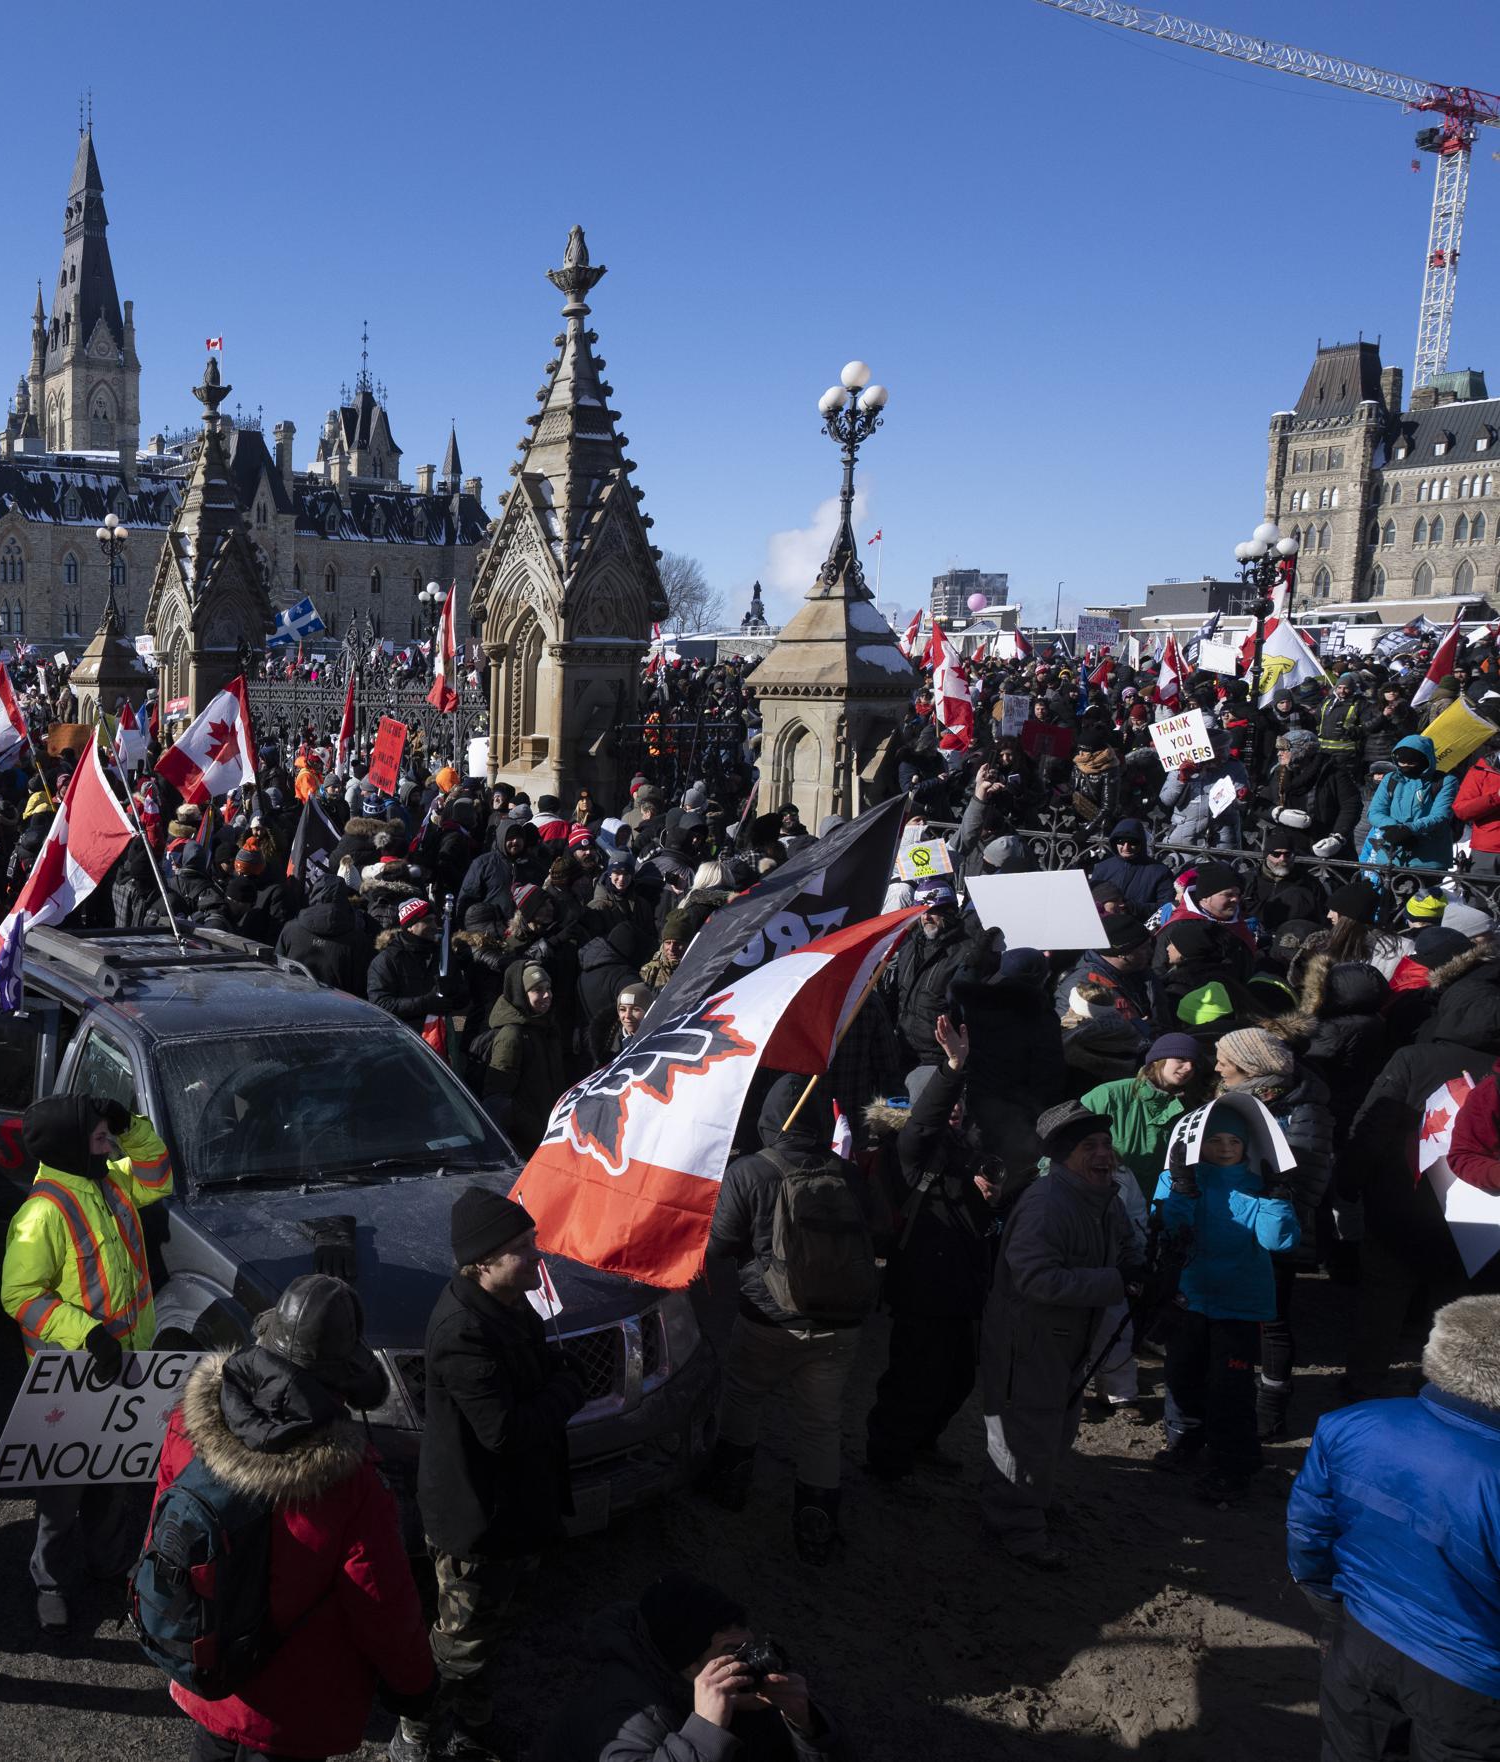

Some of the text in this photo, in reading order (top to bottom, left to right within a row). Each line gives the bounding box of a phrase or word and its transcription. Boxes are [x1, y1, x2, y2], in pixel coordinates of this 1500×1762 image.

[1156, 716, 1190, 736] THANK
[1170, 734, 1193, 749] YOU
[1162, 746, 1212, 768] TRUCKERS
[101, 1395, 145, 1432] IS
